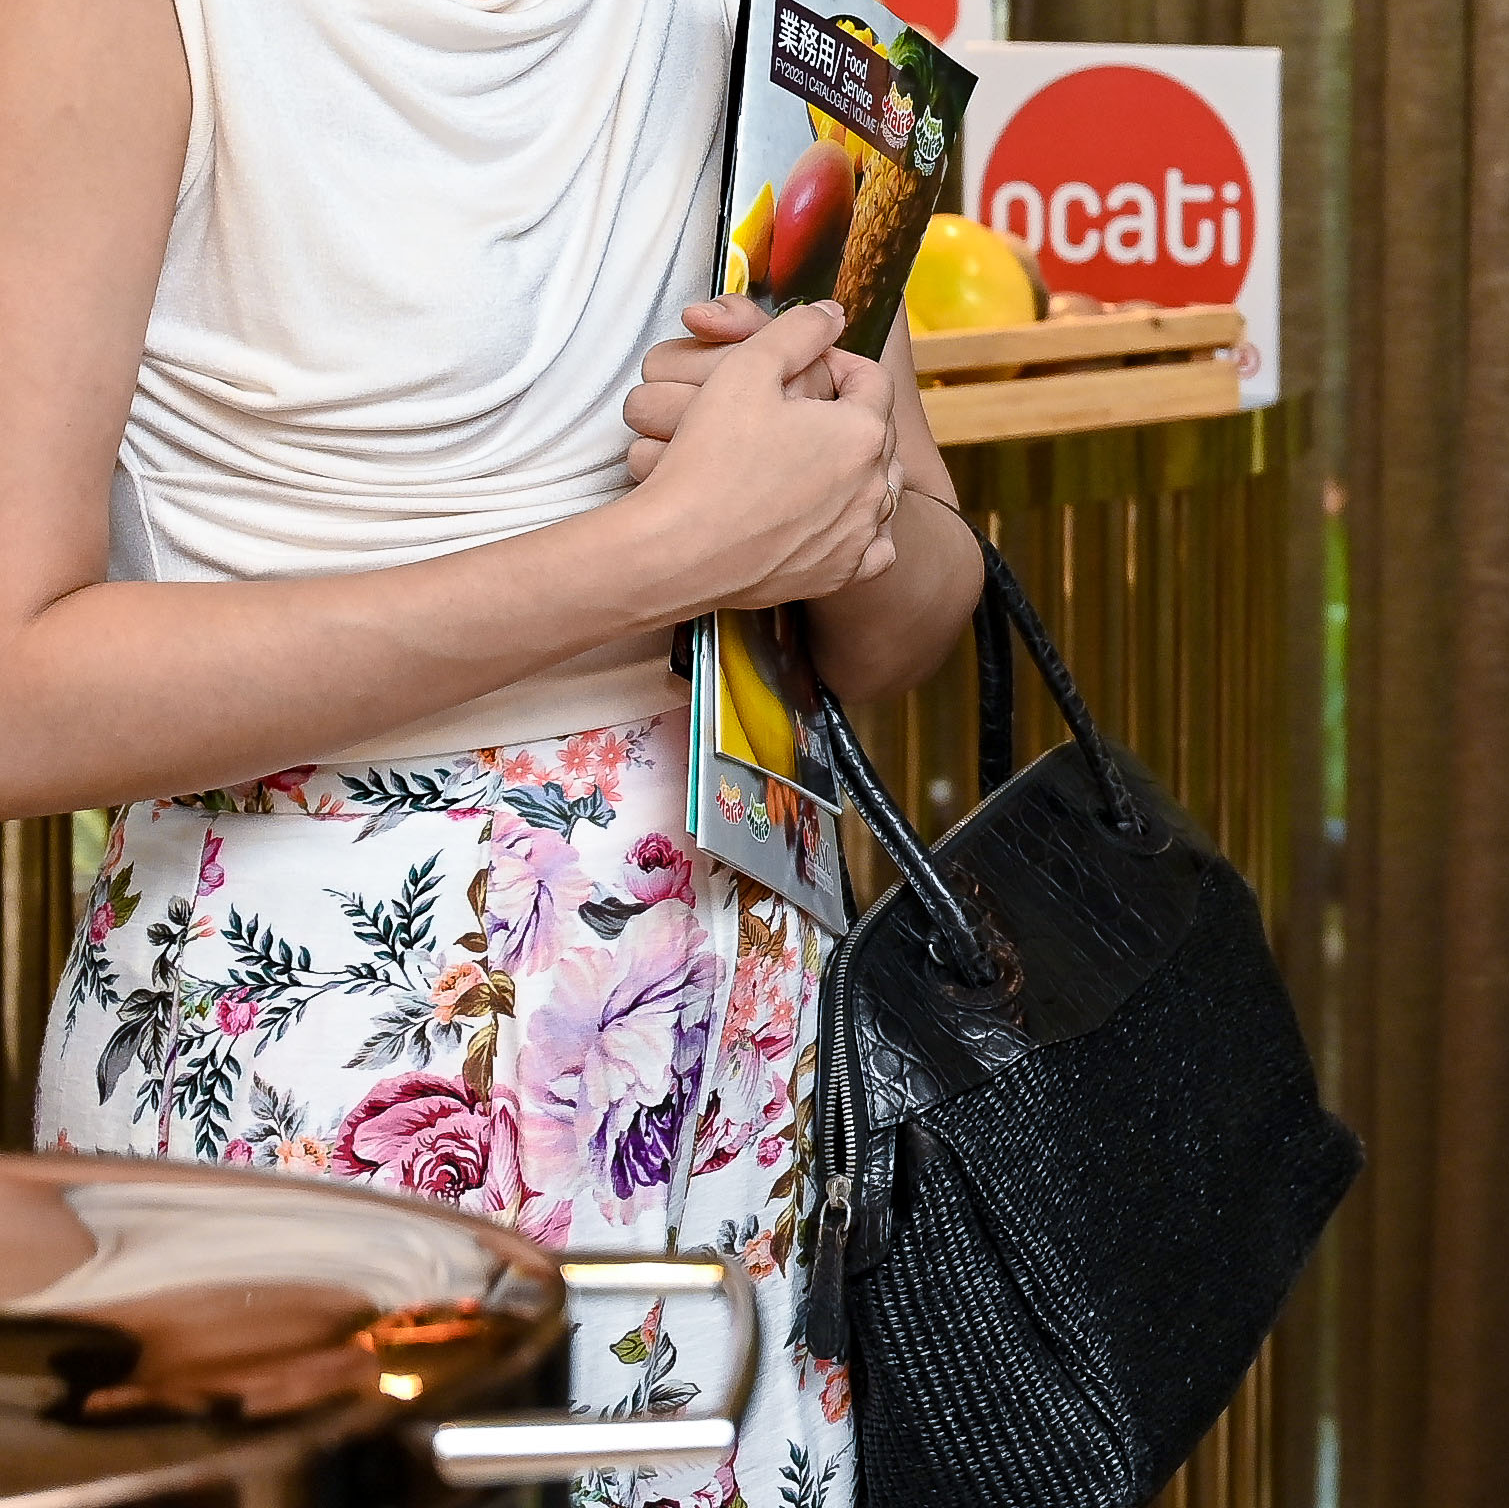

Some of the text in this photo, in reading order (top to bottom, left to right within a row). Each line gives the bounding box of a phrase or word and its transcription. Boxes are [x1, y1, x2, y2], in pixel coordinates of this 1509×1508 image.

[841, 70, 873, 111] Service
[845, 46, 869, 82] Food
[774, 56, 804, 86] FY2023
[808, 76, 850, 115] CATALOGUE
[852, 103, 878, 134] VOLUME
[991, 166, 1242, 267] ocati
